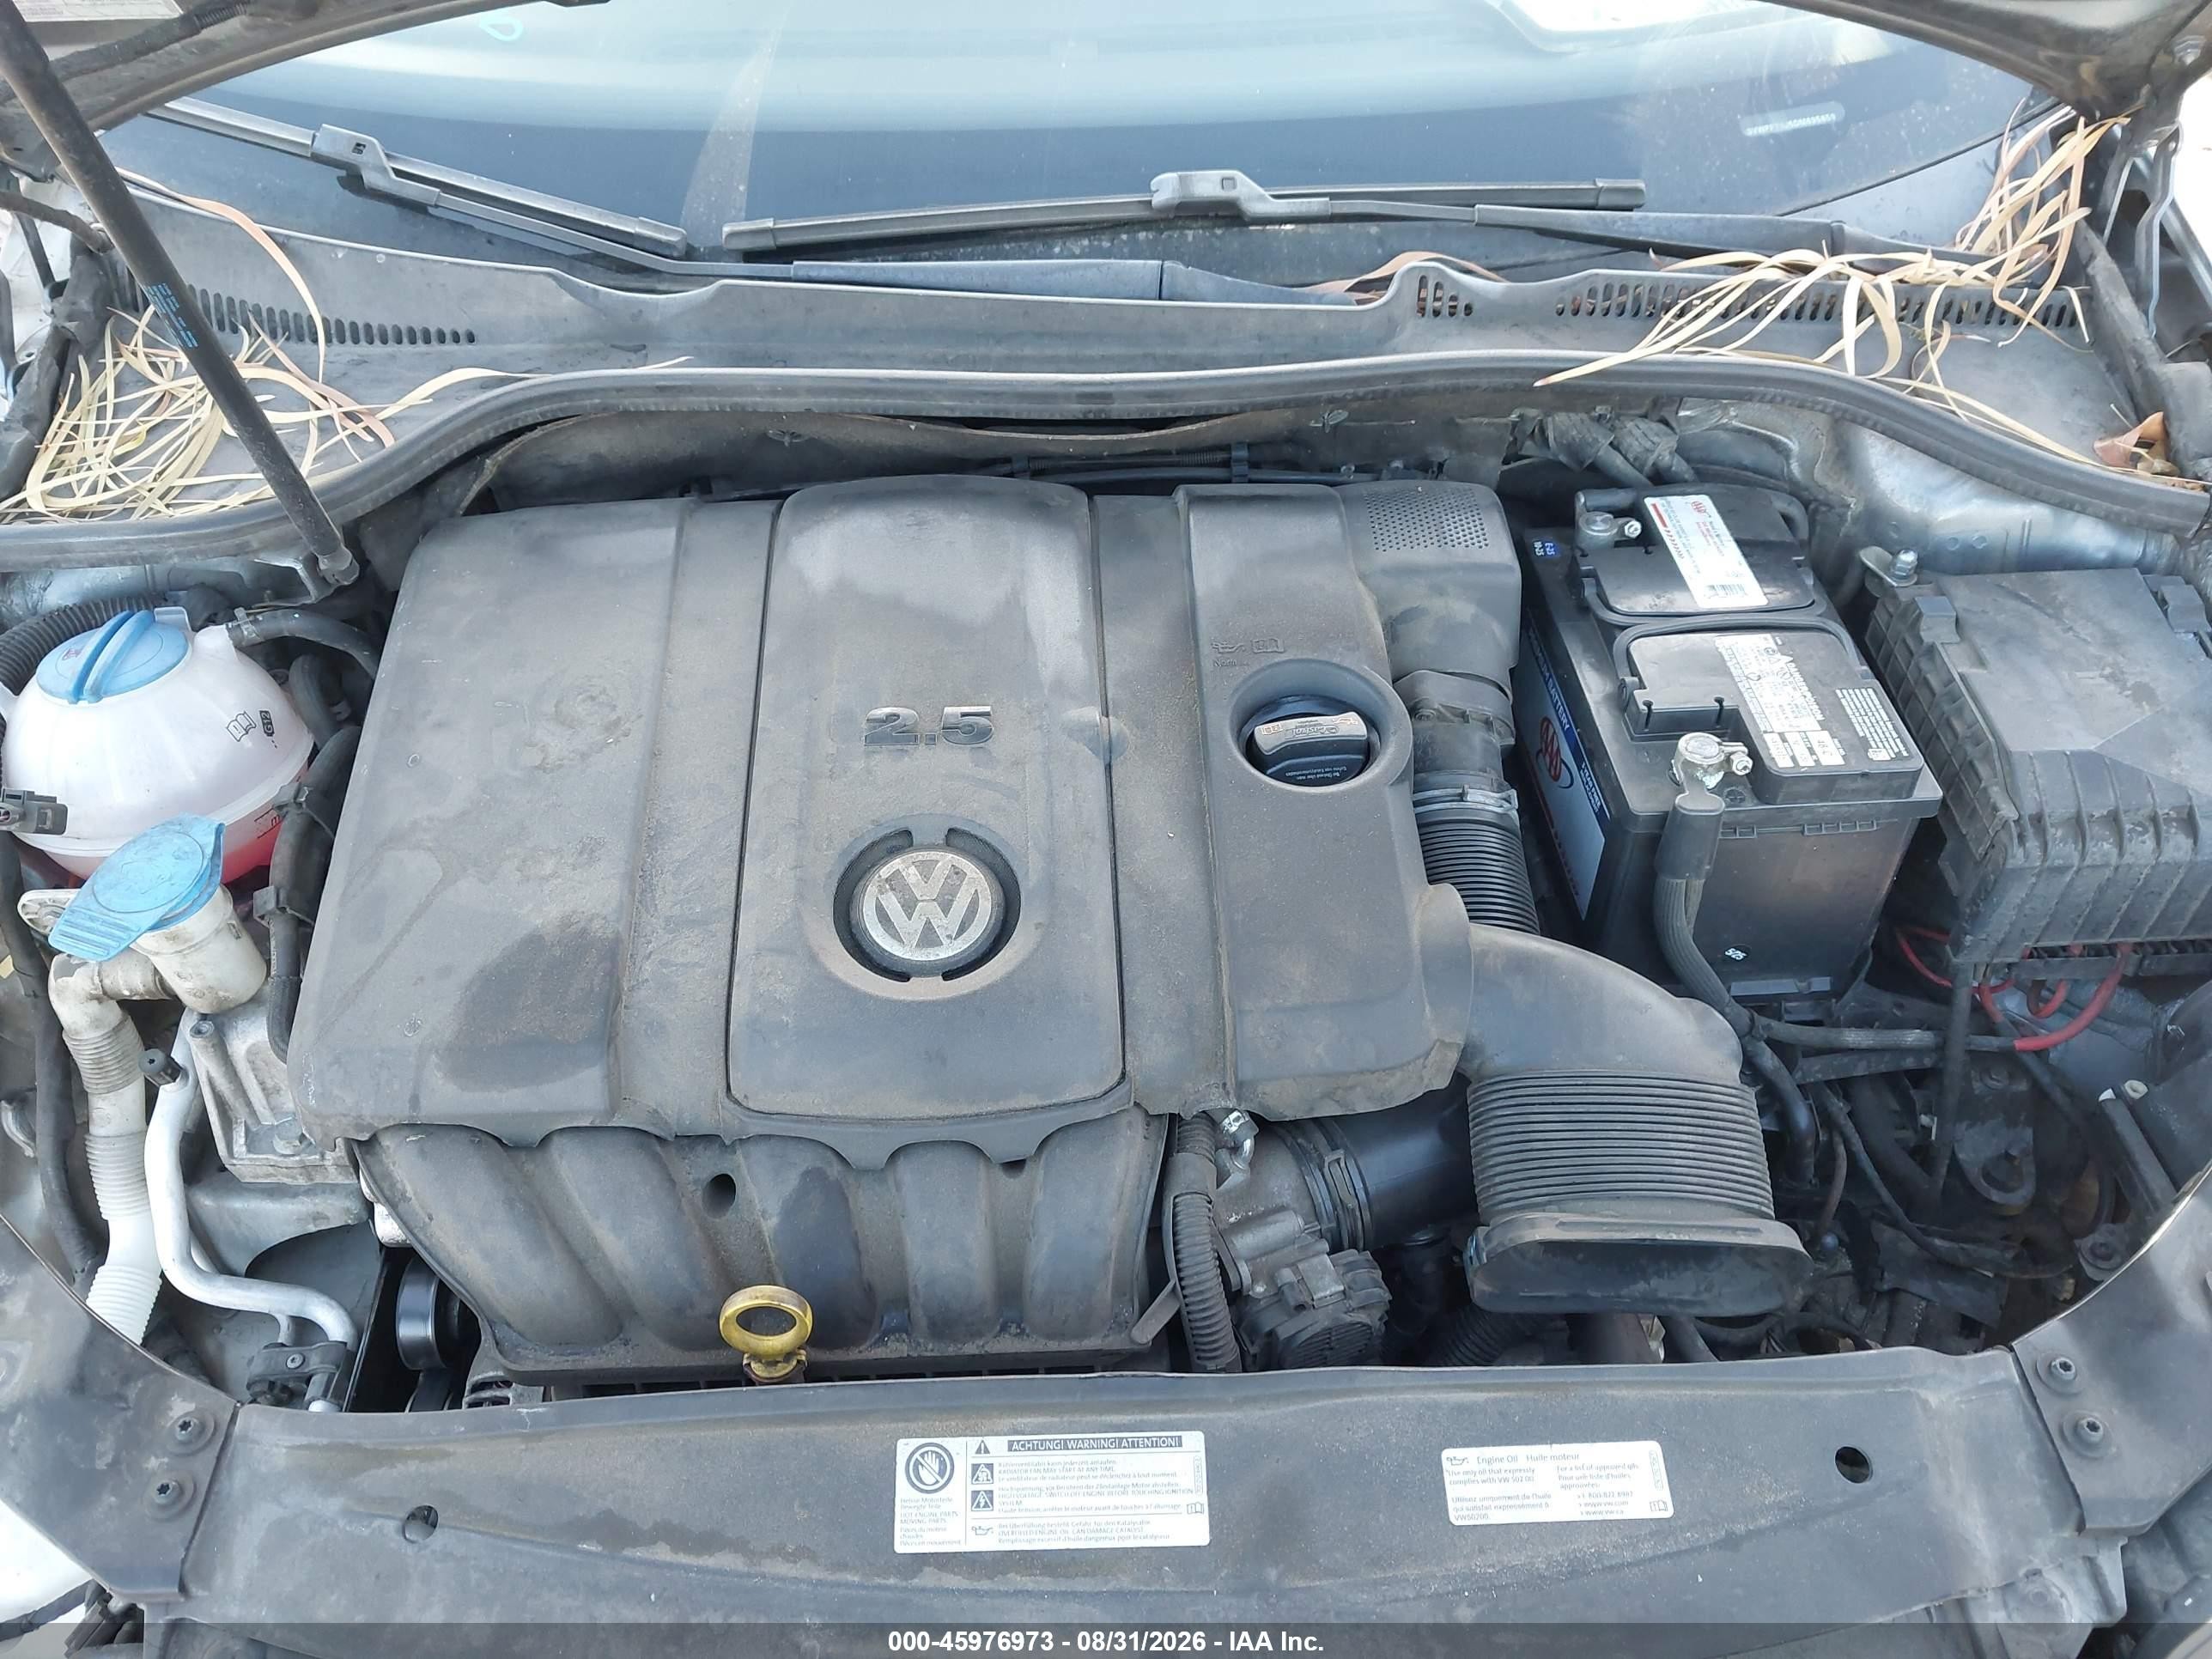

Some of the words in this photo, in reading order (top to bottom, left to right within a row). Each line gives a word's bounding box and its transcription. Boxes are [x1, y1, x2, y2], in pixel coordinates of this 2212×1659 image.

[1547, 678, 1570, 731] BATTERY
[261, 711, 275, 735] G12
[864, 706, 994, 746] 2.5
[865, 852, 991, 960] VW
[1012, 1440, 1064, 1451] ACHTUNG!
[1066, 1438, 1118, 1449] WARNING!
[1121, 1437, 1179, 1449] ATTENTION!
[1477, 1456, 1504, 1465] Engine
[1507, 1455, 1518, 1463] Oil
[1550, 1453, 1579, 1462] moteur
